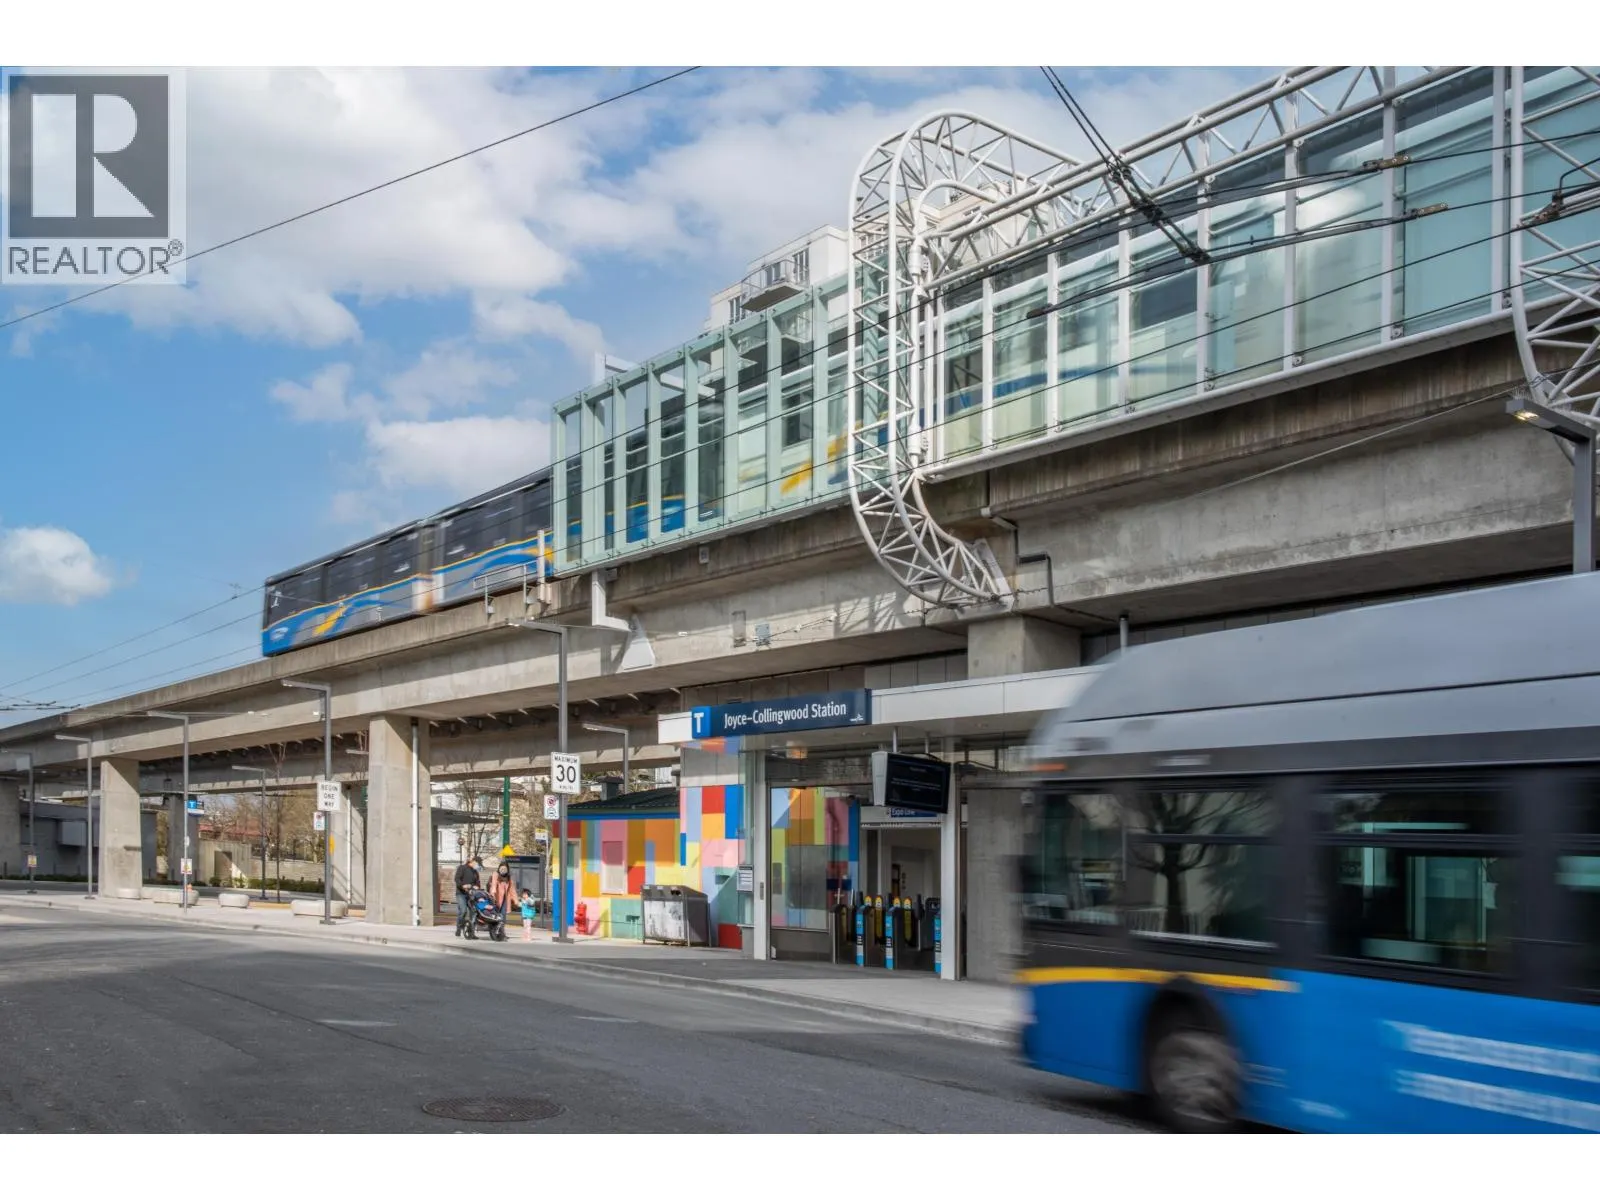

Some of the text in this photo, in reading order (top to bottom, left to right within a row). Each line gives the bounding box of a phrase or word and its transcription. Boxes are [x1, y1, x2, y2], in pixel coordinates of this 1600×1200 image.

[811, 701, 847, 718] Station
[554, 755, 578, 764] MAXIMUM
[556, 764, 577, 784] 30
[321, 784, 338, 792] BEGIN
